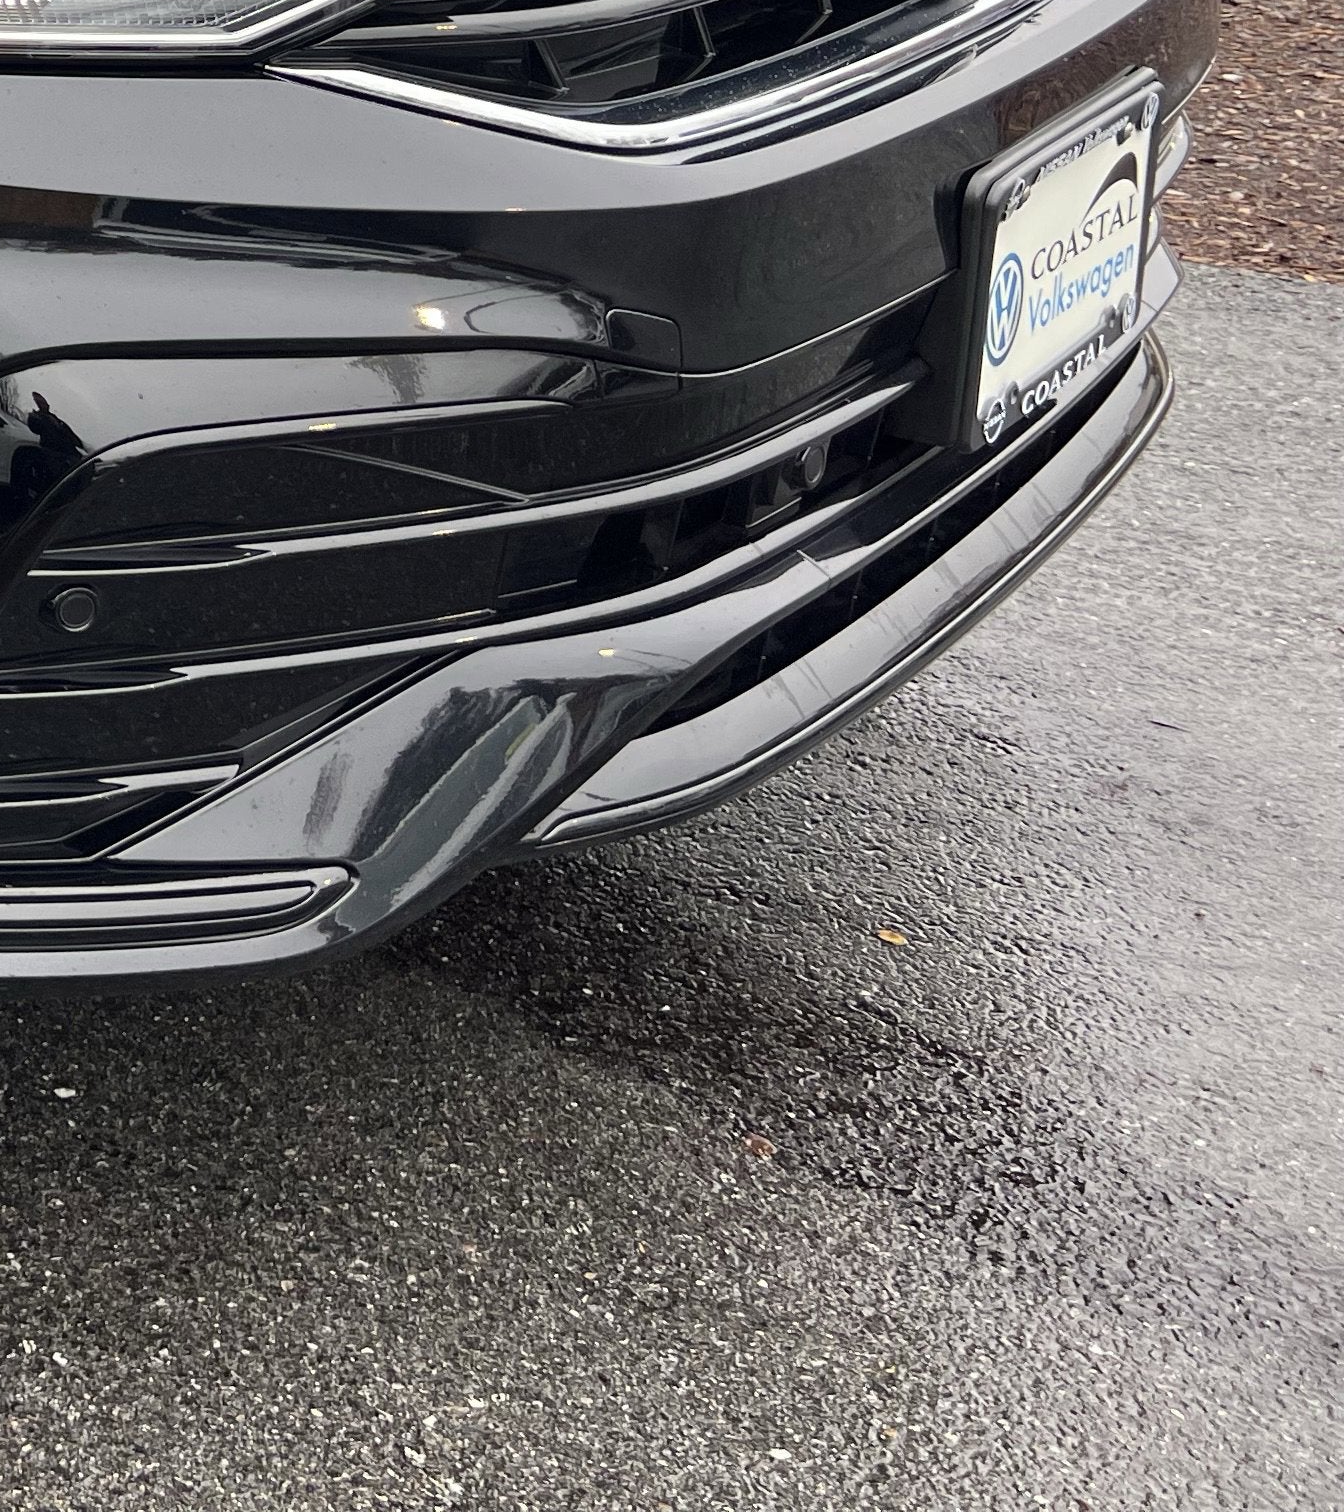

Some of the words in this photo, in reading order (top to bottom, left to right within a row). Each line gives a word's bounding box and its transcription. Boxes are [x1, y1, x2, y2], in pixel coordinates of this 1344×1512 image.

[1030, 193, 1139, 281] COASTAL
[1028, 242, 1136, 337] Volkswagen
[1021, 334, 1107, 416] COASTAL
